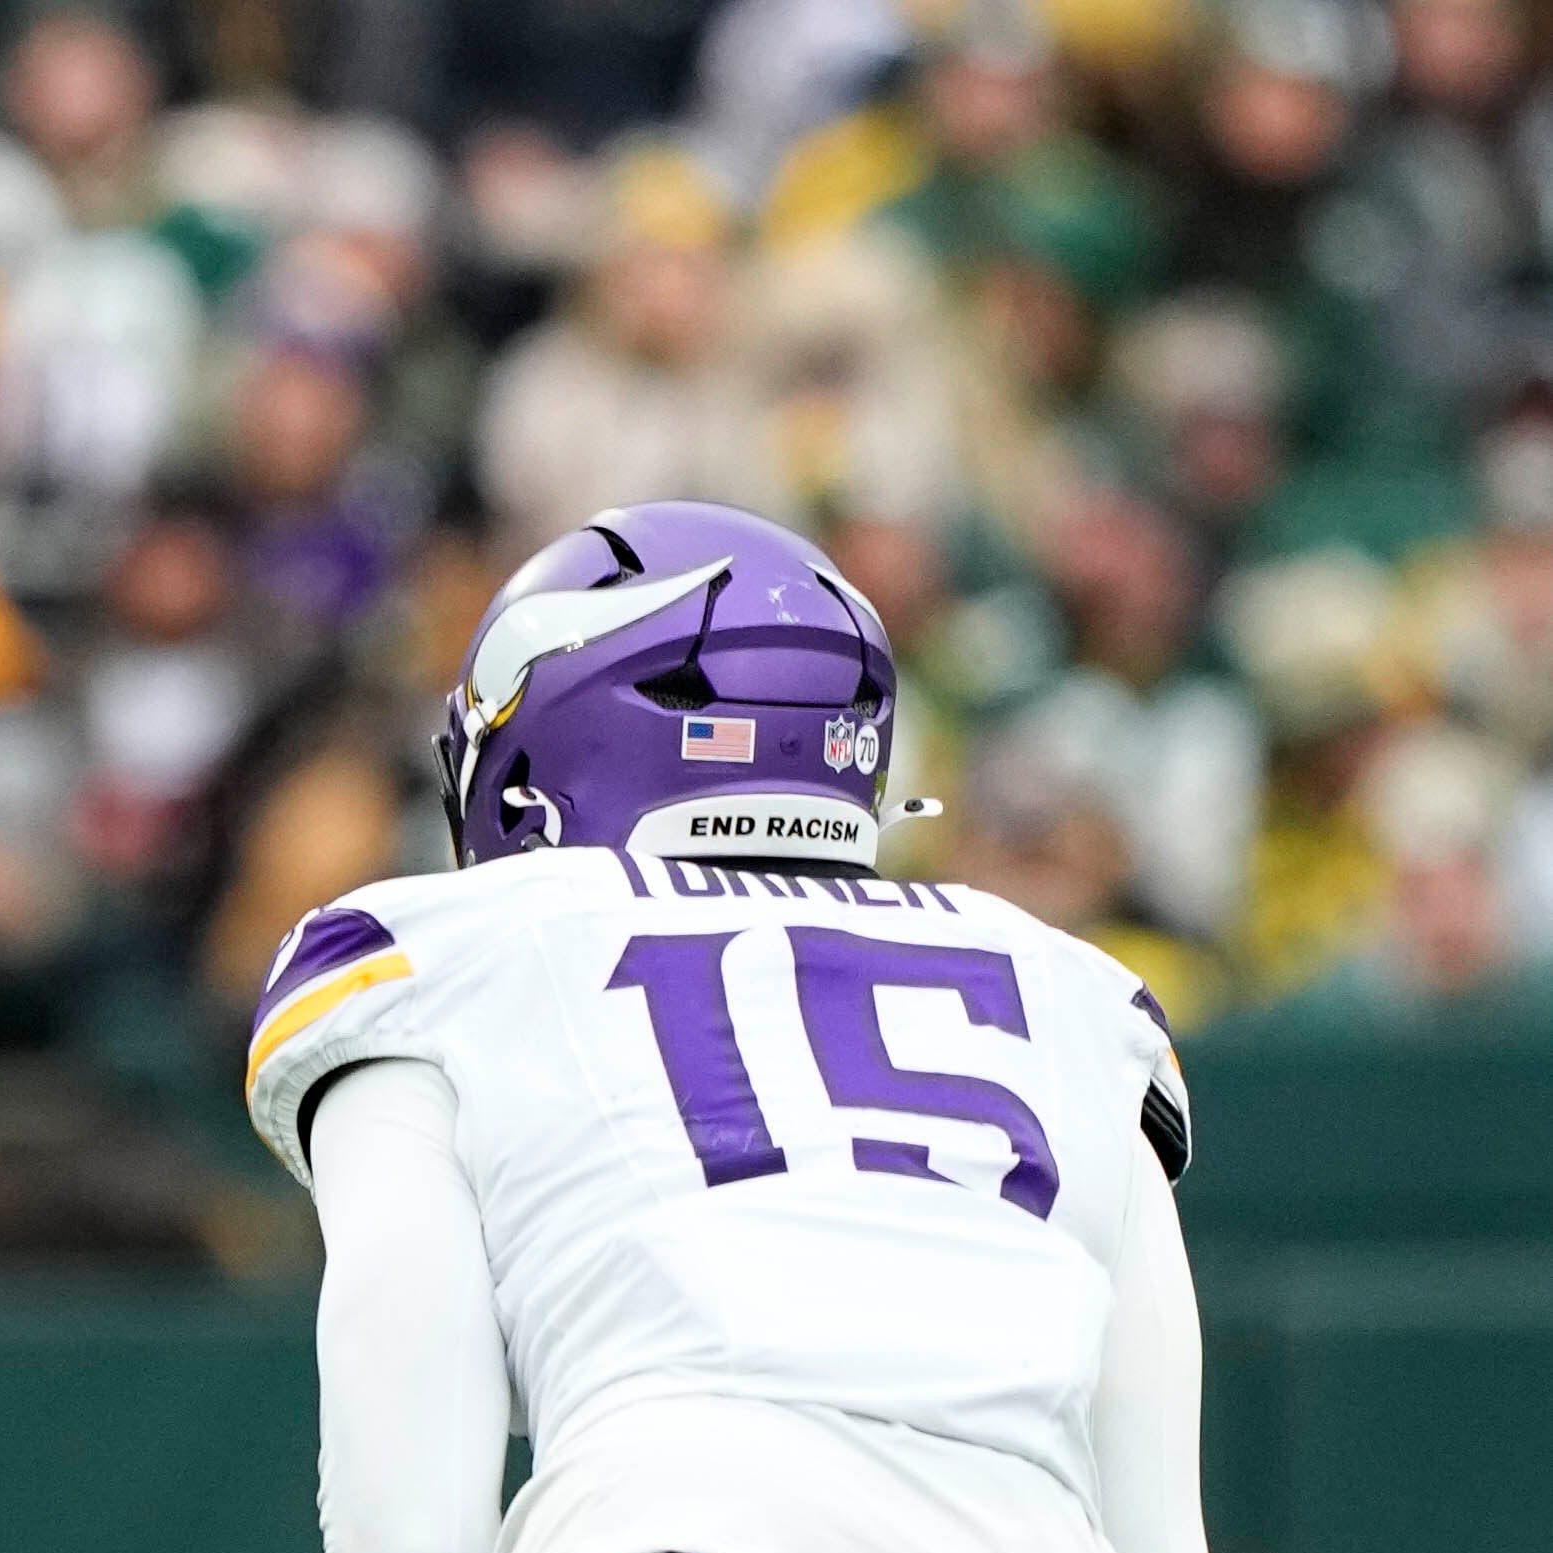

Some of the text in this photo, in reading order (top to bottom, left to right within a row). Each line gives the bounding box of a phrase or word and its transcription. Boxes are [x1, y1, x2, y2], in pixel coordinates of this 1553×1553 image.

[829, 740, 851, 762] NFL
[860, 736, 876, 762] 70
[690, 816, 859, 844] END RACISM
[603, 925, 1061, 1223] 15
